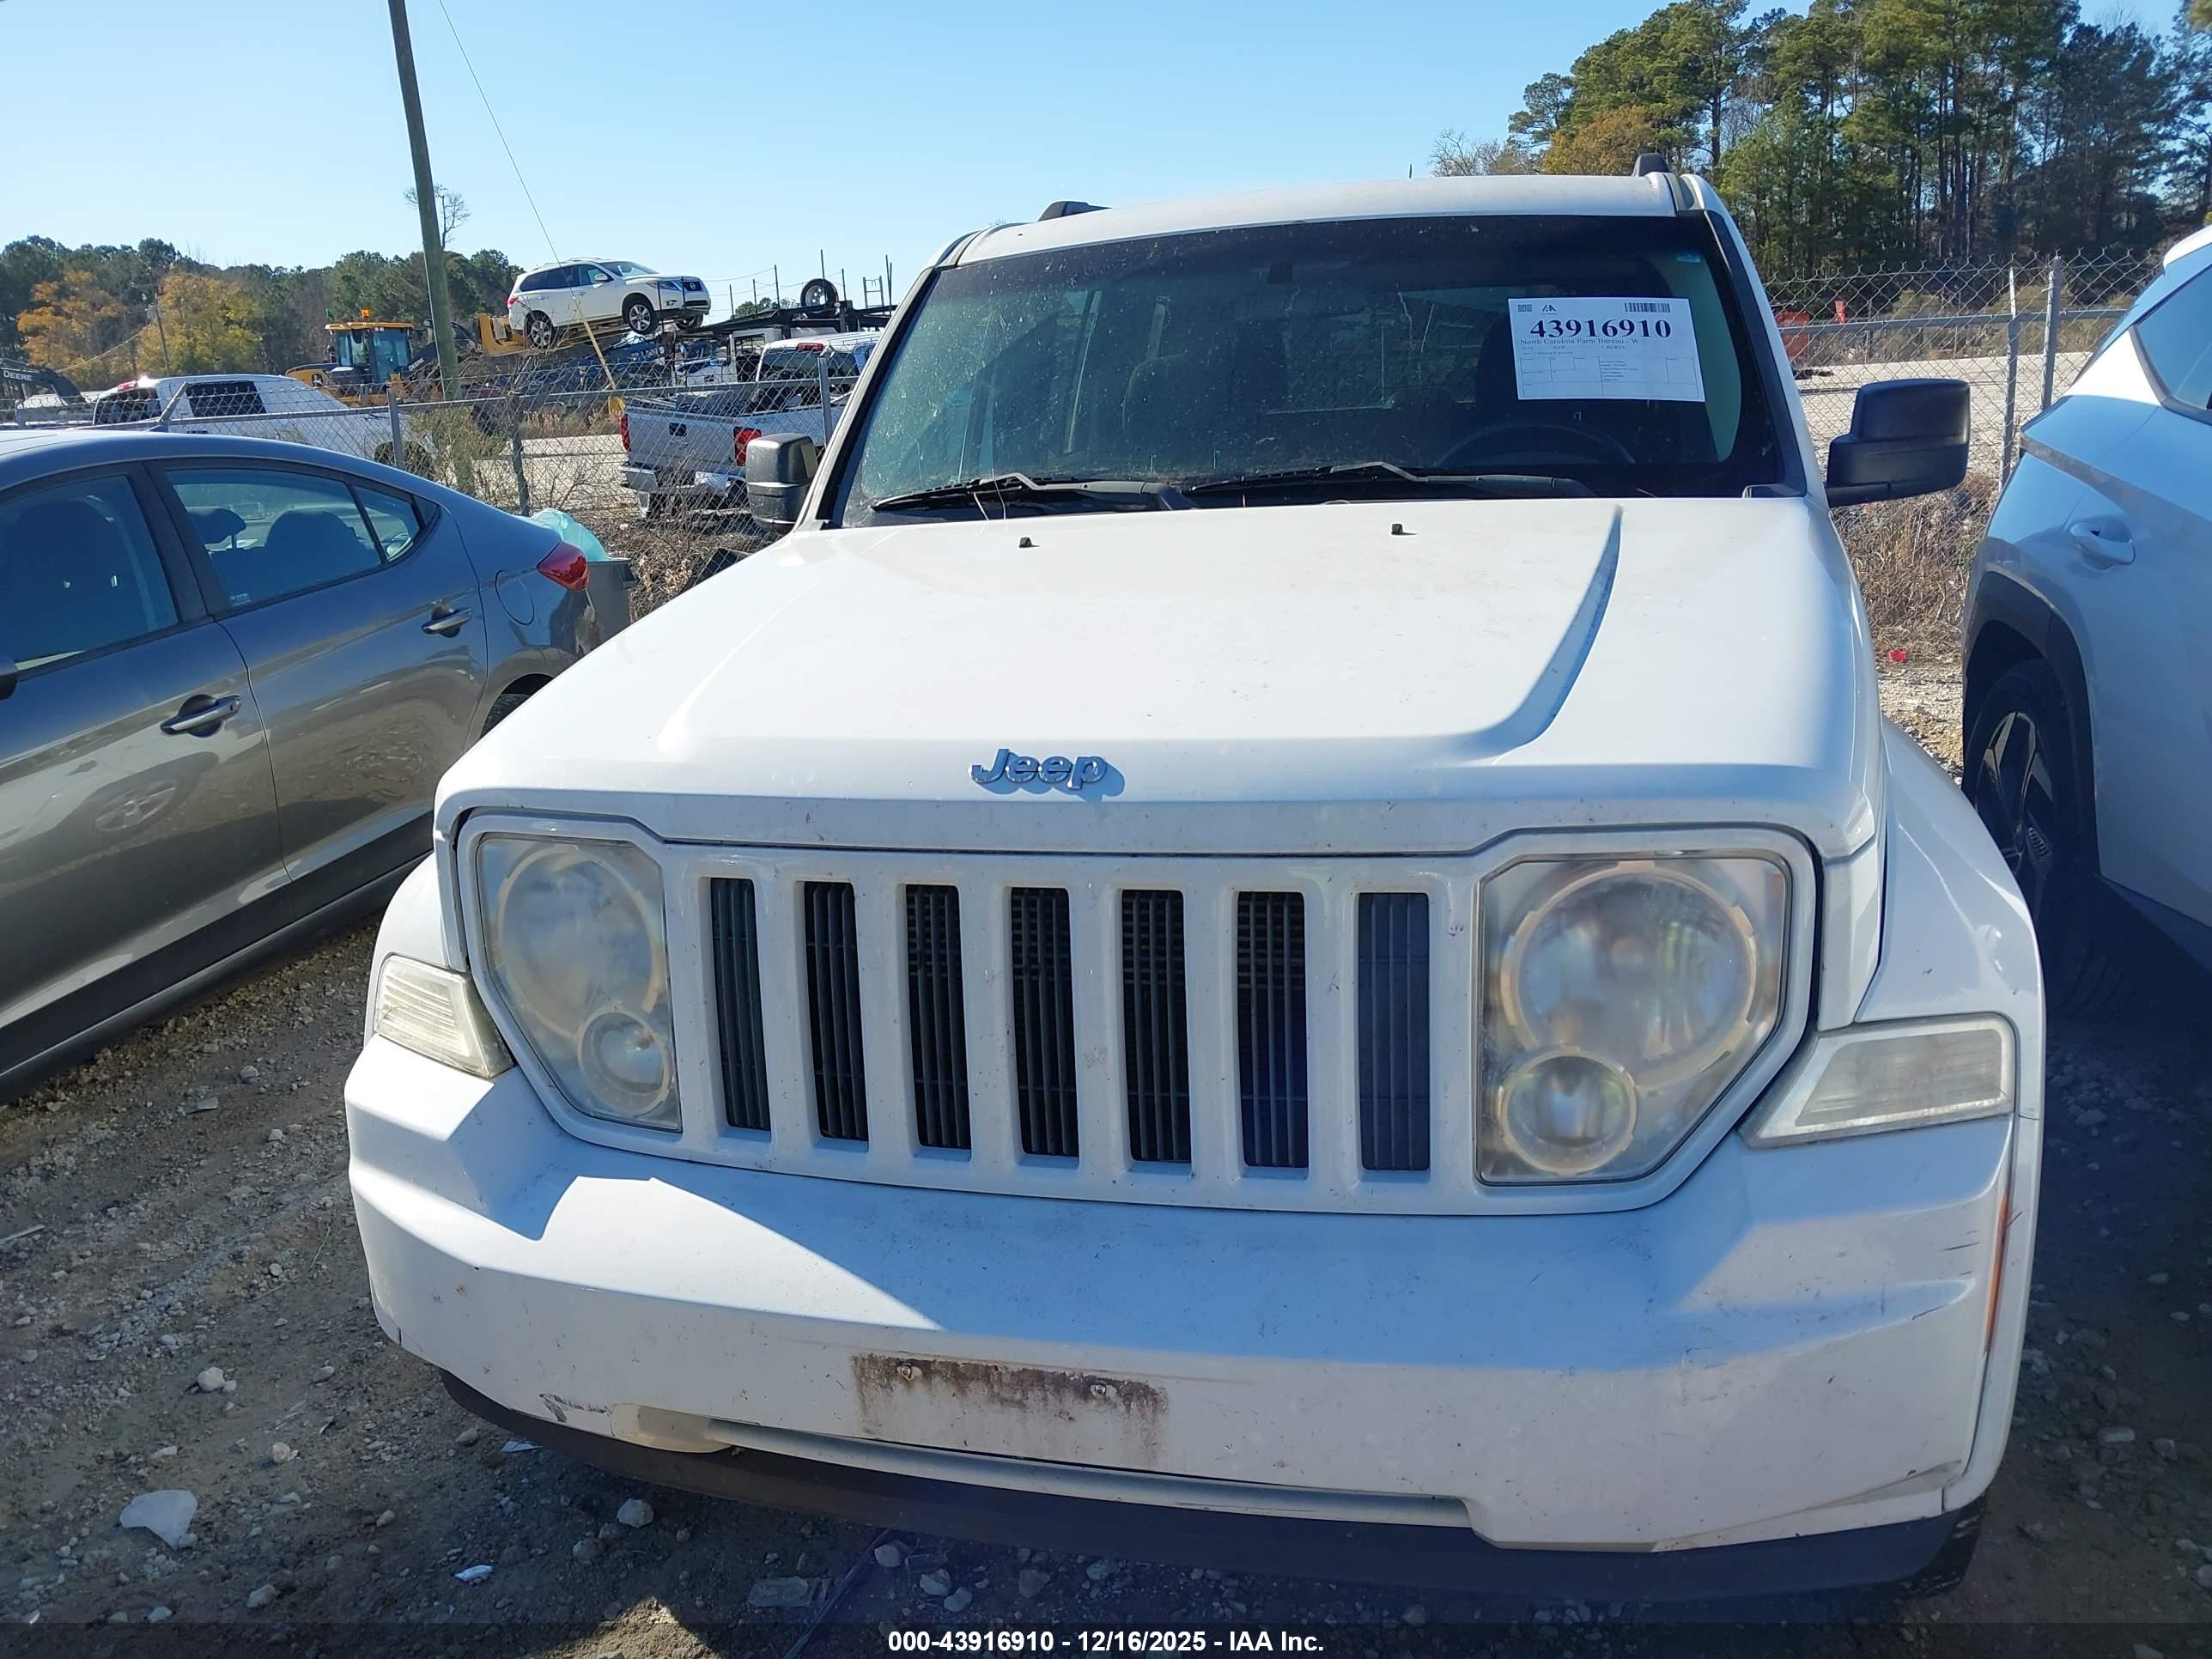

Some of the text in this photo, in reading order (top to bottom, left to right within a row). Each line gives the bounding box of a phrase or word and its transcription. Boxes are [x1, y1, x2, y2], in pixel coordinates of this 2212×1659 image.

[1530, 319, 1672, 337] 43916910
[3, 370, 33, 380] DEERE
[969, 748, 1108, 791] Jeep
